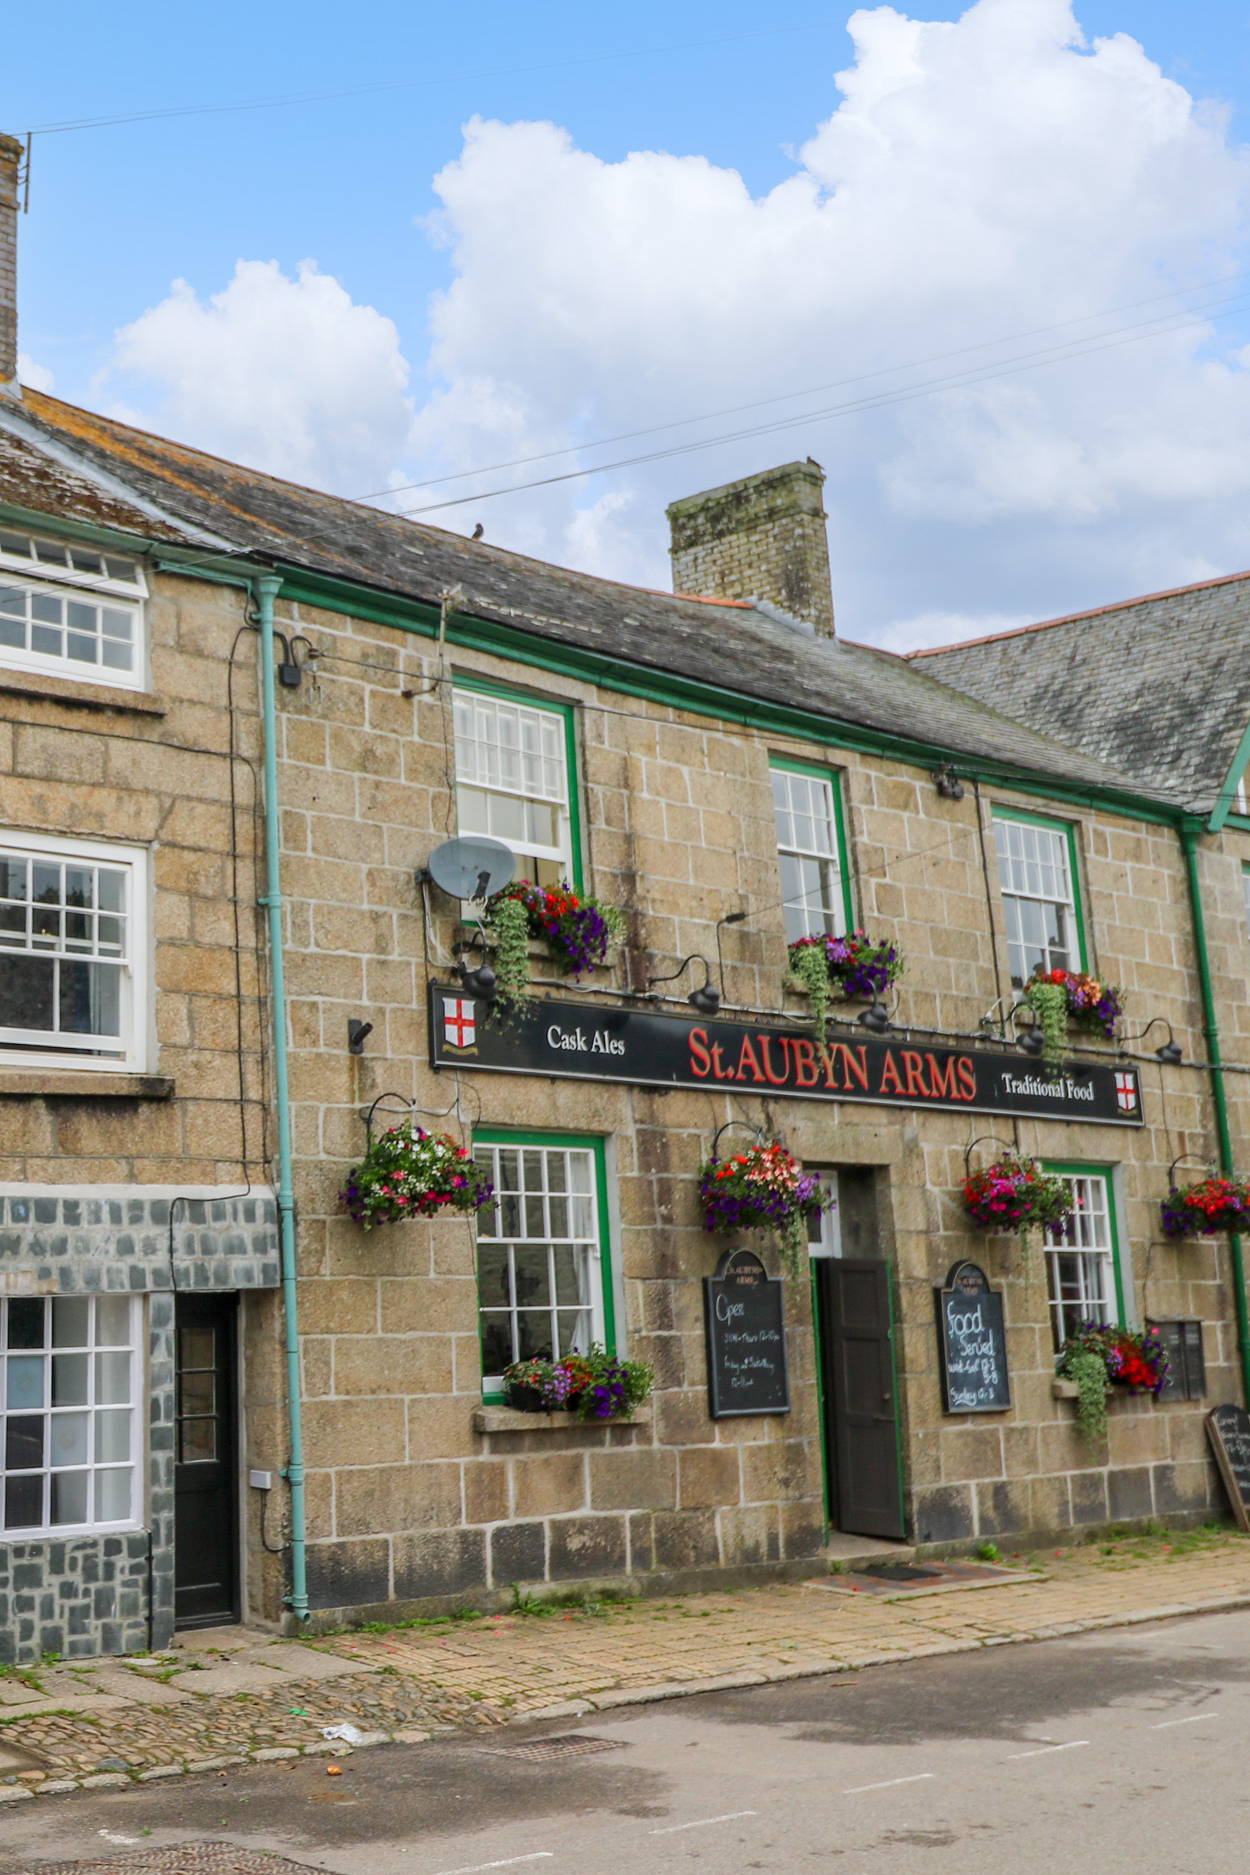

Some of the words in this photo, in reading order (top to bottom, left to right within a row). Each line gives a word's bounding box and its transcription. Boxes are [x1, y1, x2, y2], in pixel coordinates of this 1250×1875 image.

[547, 1024, 588, 1051] Cask
[591, 1030, 626, 1055] Ales
[879, 1049, 976, 1101] ARMS
[1001, 1072, 1065, 1098] Traditional
[1066, 1079, 1095, 1101] Food
[716, 1293, 745, 1327] Open
[960, 1328, 996, 1357] Served
